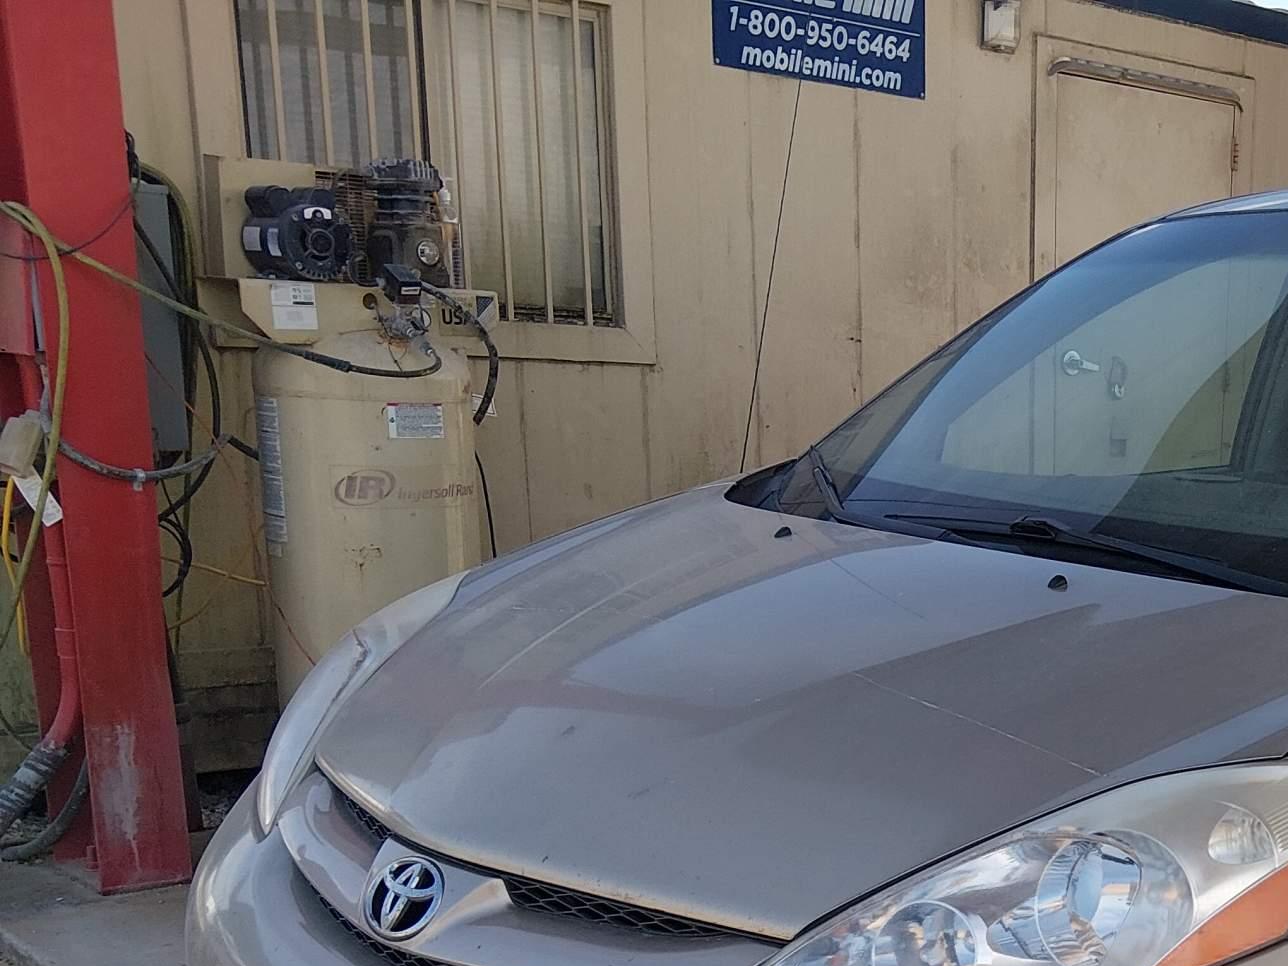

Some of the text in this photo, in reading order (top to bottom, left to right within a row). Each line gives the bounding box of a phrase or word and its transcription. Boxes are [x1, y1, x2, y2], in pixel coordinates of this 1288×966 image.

[729, 5, 911, 62] 1-800-950-6464
[741, 46, 902, 91] mobilemini.com
[441, 308, 467, 325] US
